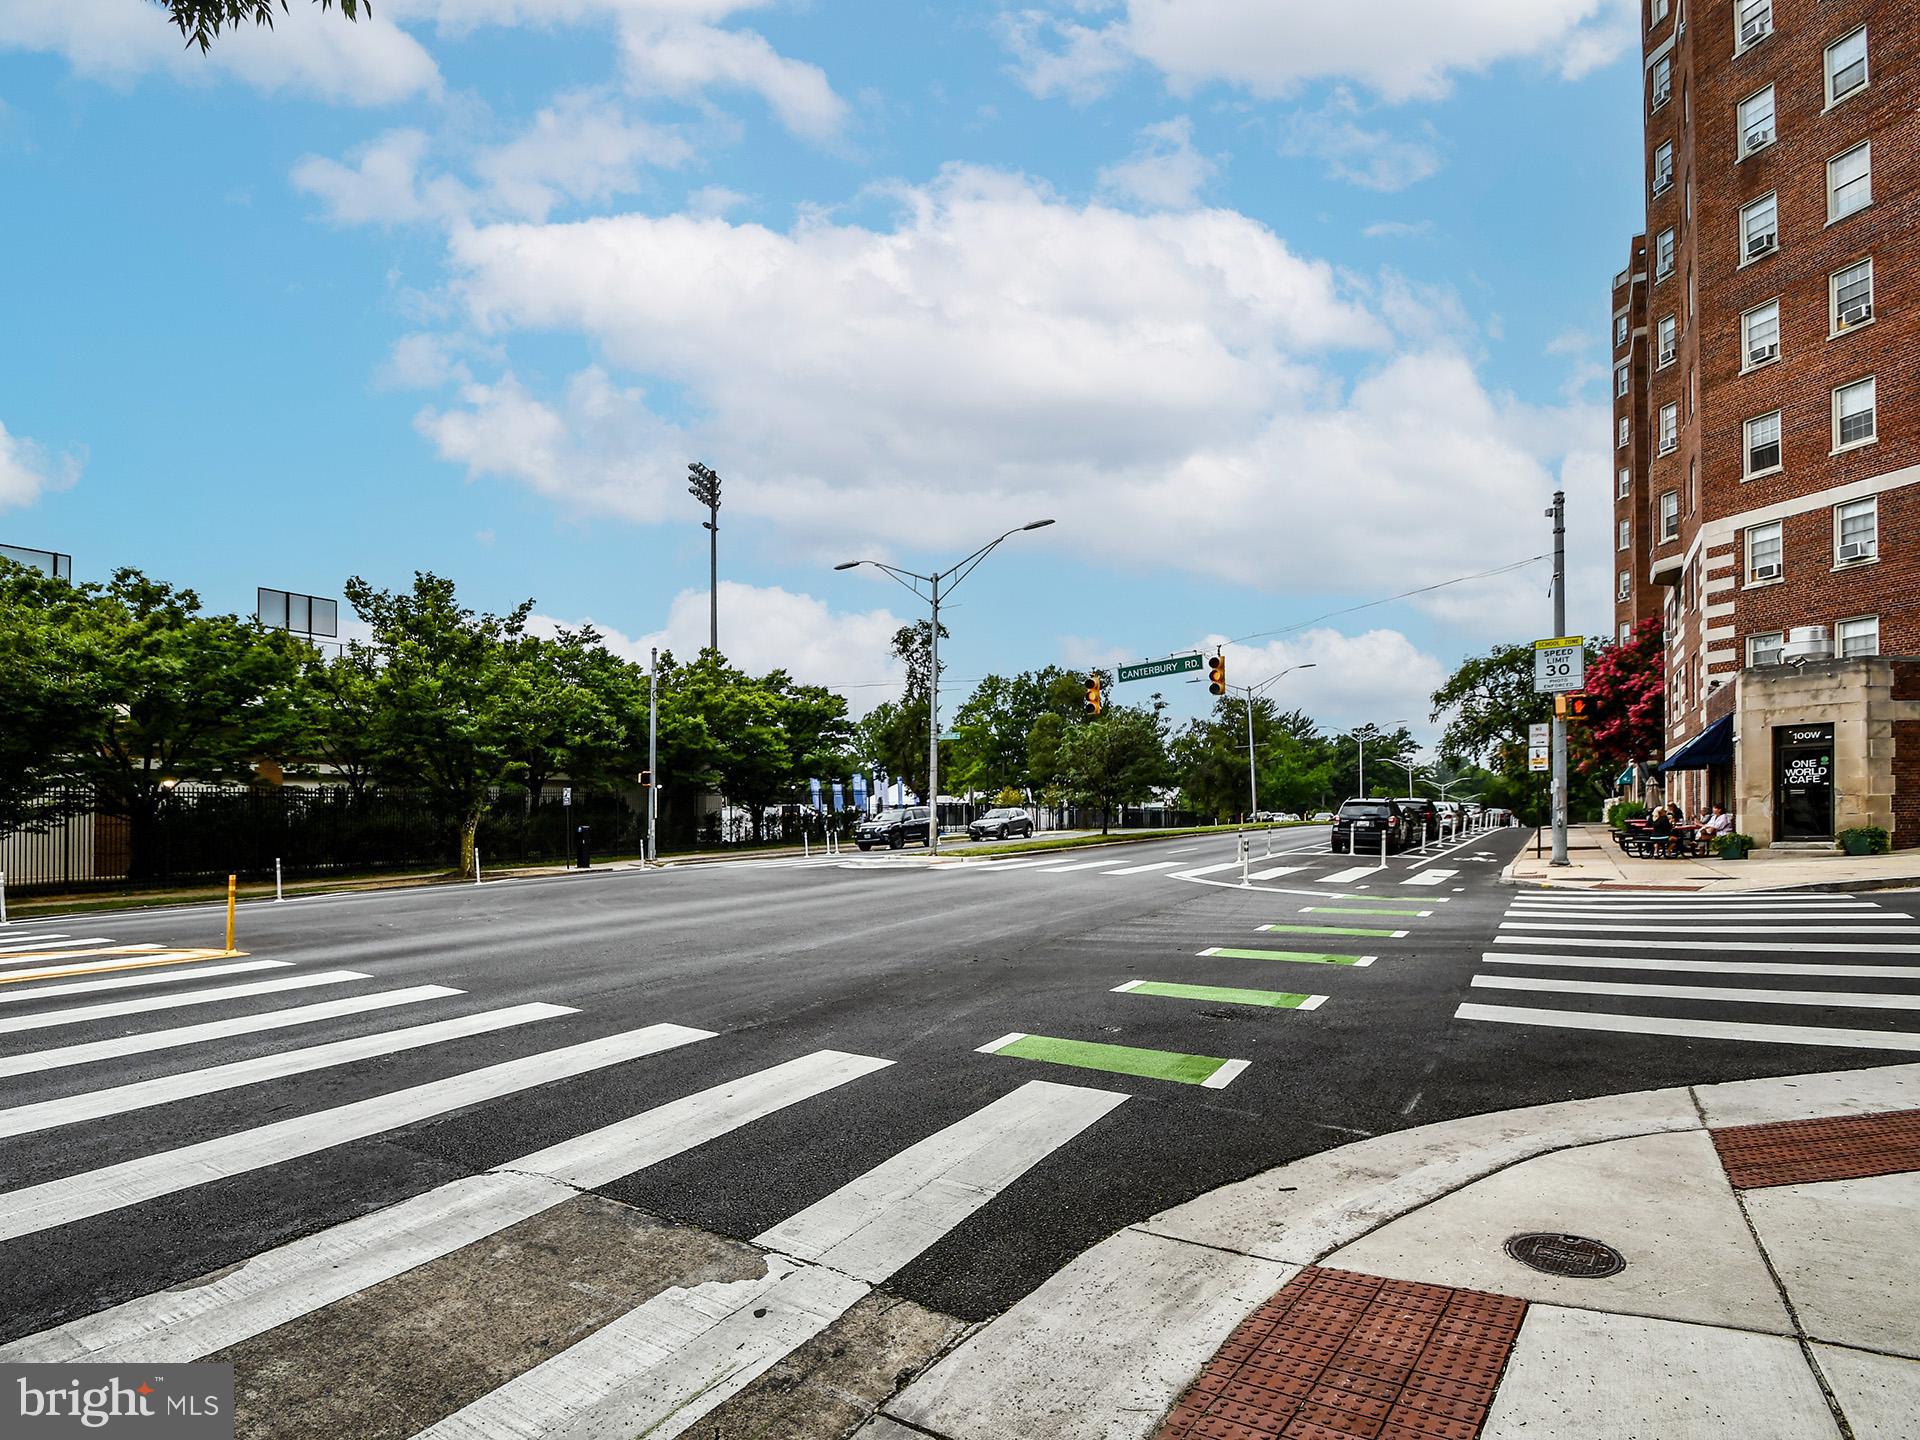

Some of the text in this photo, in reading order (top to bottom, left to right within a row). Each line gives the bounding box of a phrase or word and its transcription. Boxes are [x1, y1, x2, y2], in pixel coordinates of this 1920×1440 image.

[1544, 648, 1573, 657] SPEED
[1546, 656, 1570, 664] LIMIT
[1121, 660, 1200, 679] CANTERBURY RD.
[1546, 664, 1570, 676] 30
[1793, 731, 1821, 740] 100W
[1792, 759, 1817, 768] ONE
[1785, 767, 1827, 777] WORLD
[1789, 775, 1821, 784] CAFE
